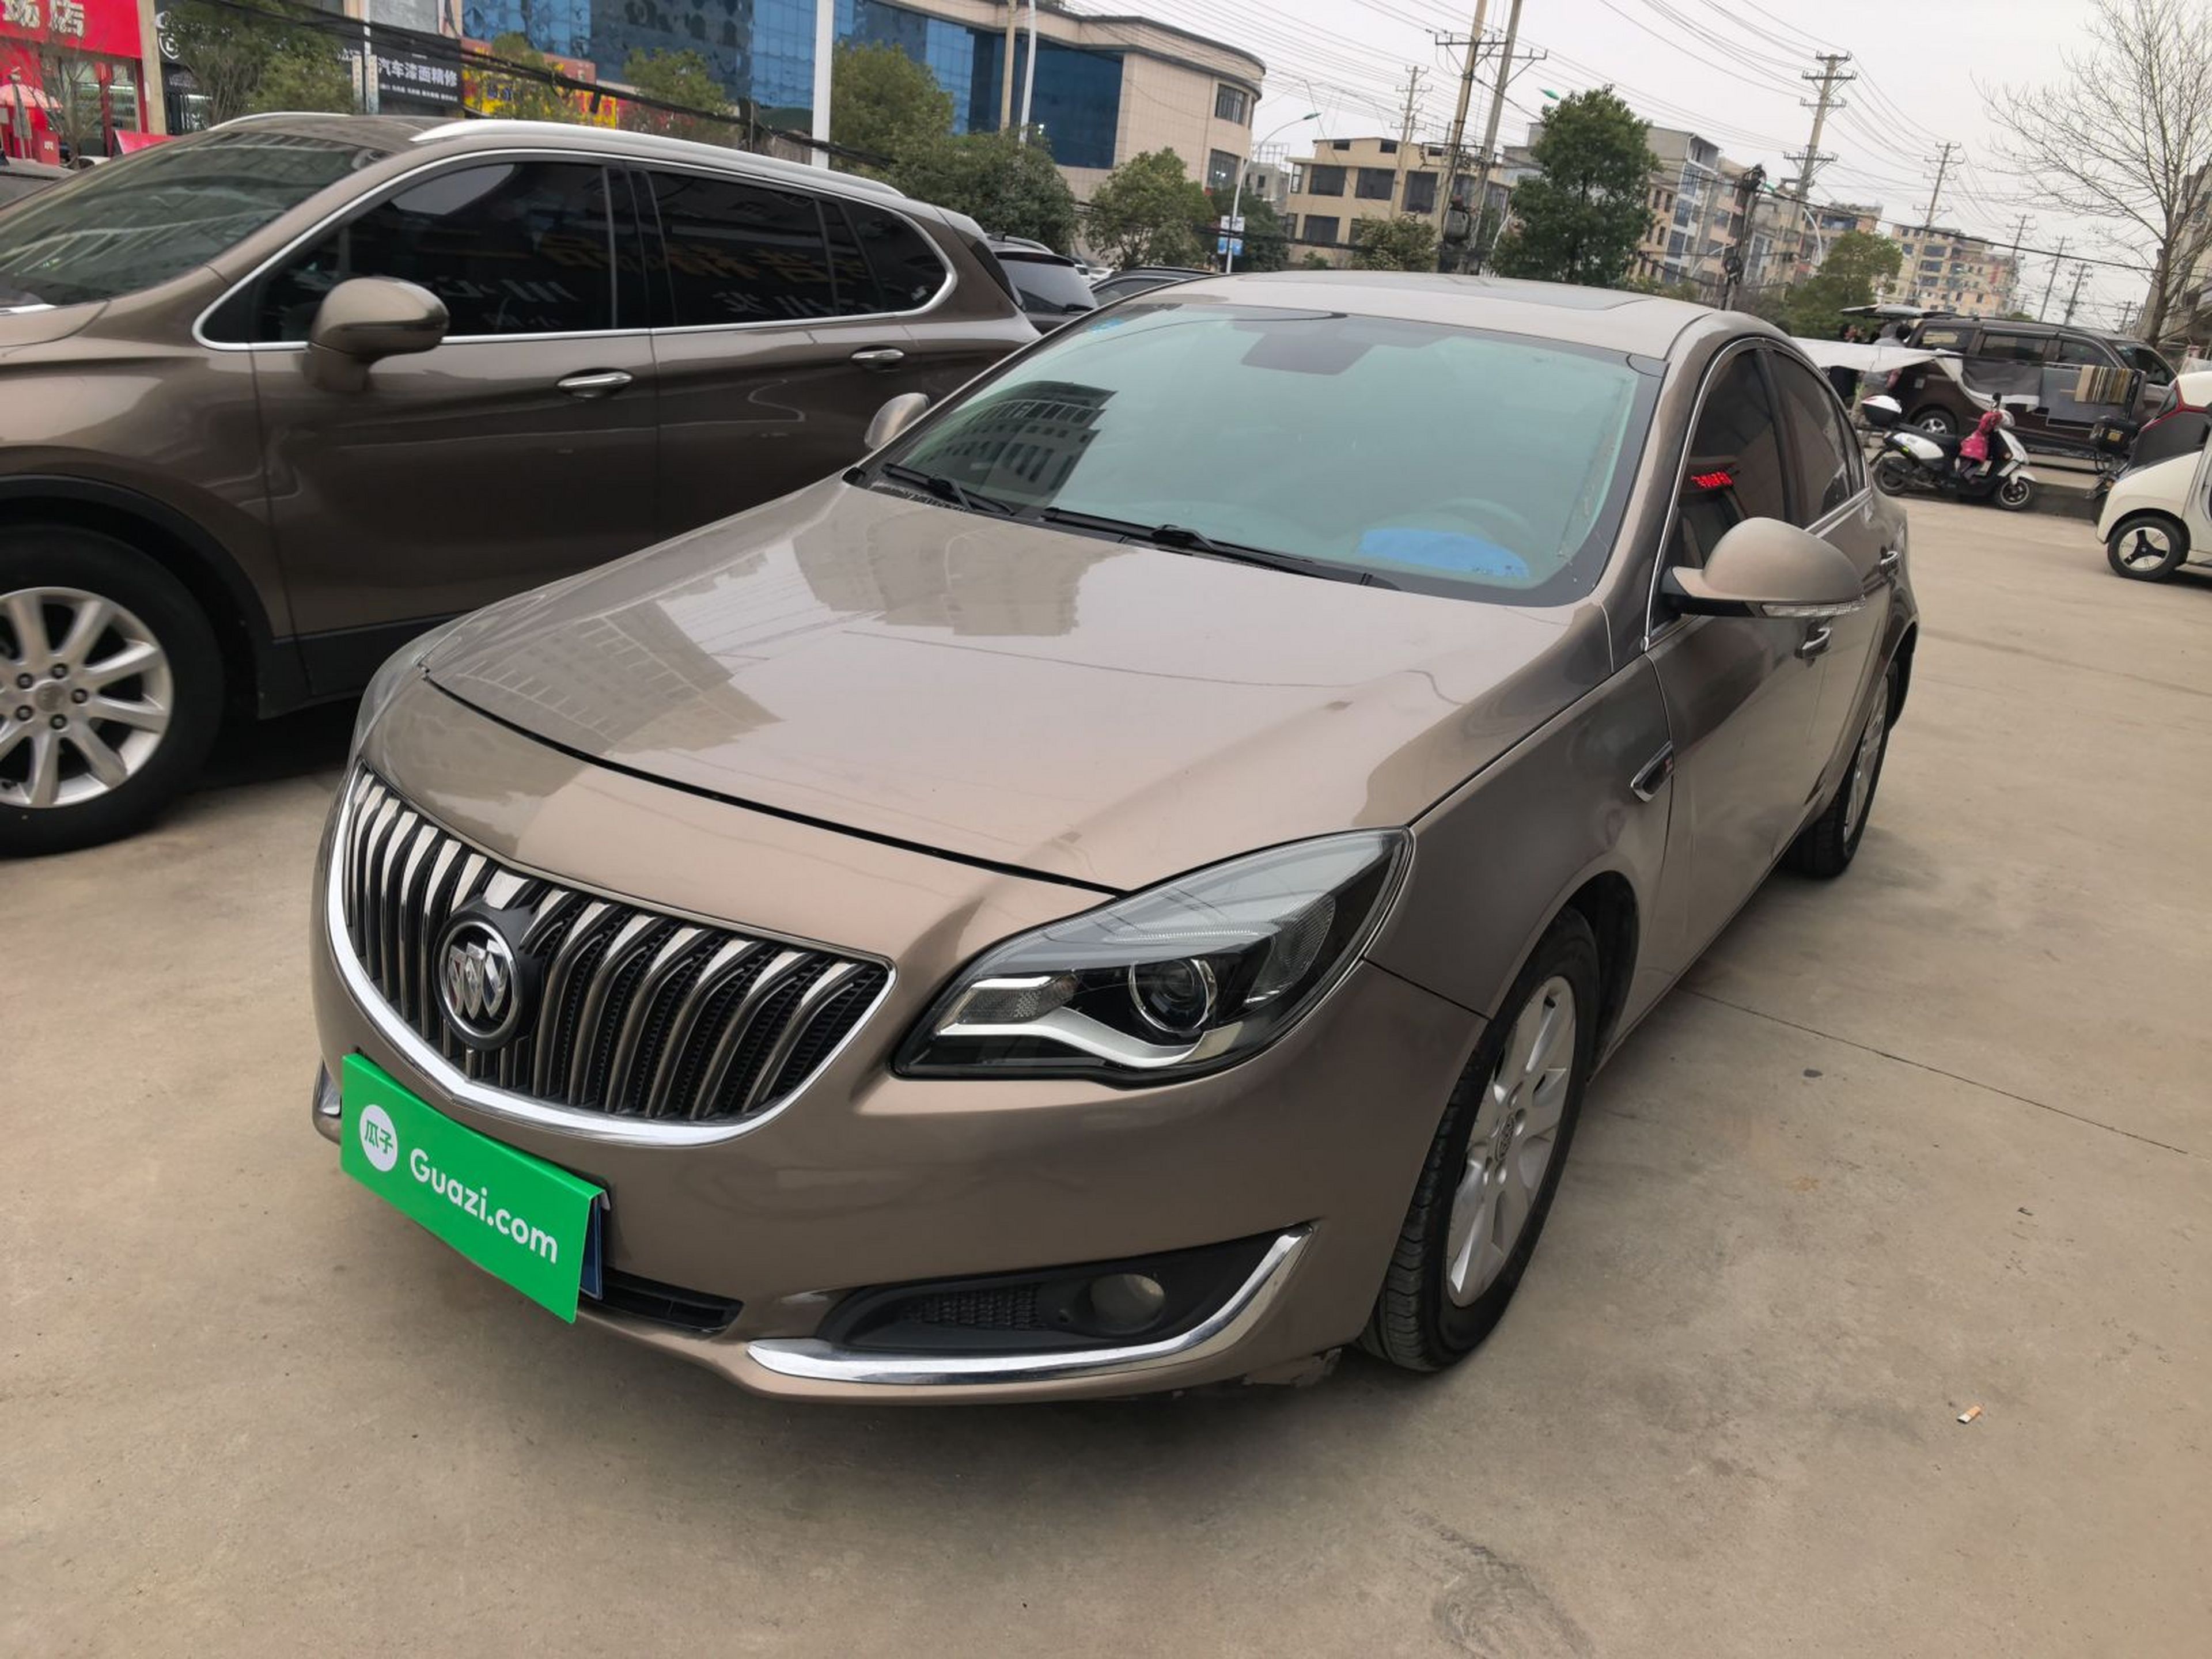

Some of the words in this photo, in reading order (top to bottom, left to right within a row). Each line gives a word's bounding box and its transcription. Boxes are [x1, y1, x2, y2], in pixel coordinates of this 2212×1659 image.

[378, 57, 457, 87] 汽车漆面精修
[365, 1120, 393, 1154] 瓜子
[410, 1148, 558, 1264] Guazi.com
